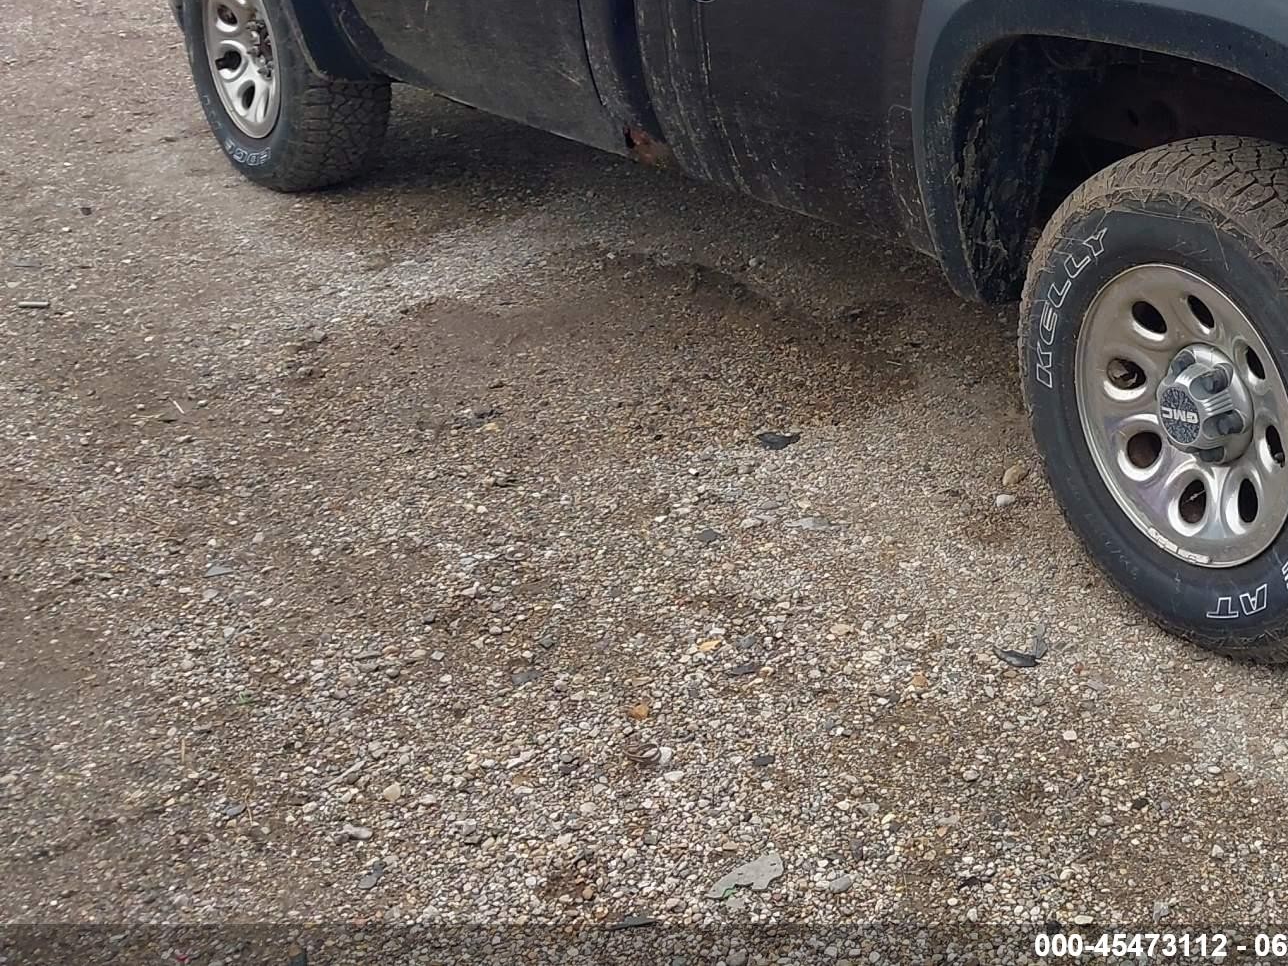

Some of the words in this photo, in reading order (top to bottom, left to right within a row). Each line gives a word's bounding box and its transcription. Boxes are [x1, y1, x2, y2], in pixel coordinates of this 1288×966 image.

[1036, 227, 1108, 388] KELLY
[1161, 406, 1200, 424] GMC
[1206, 583, 1268, 618] AT
